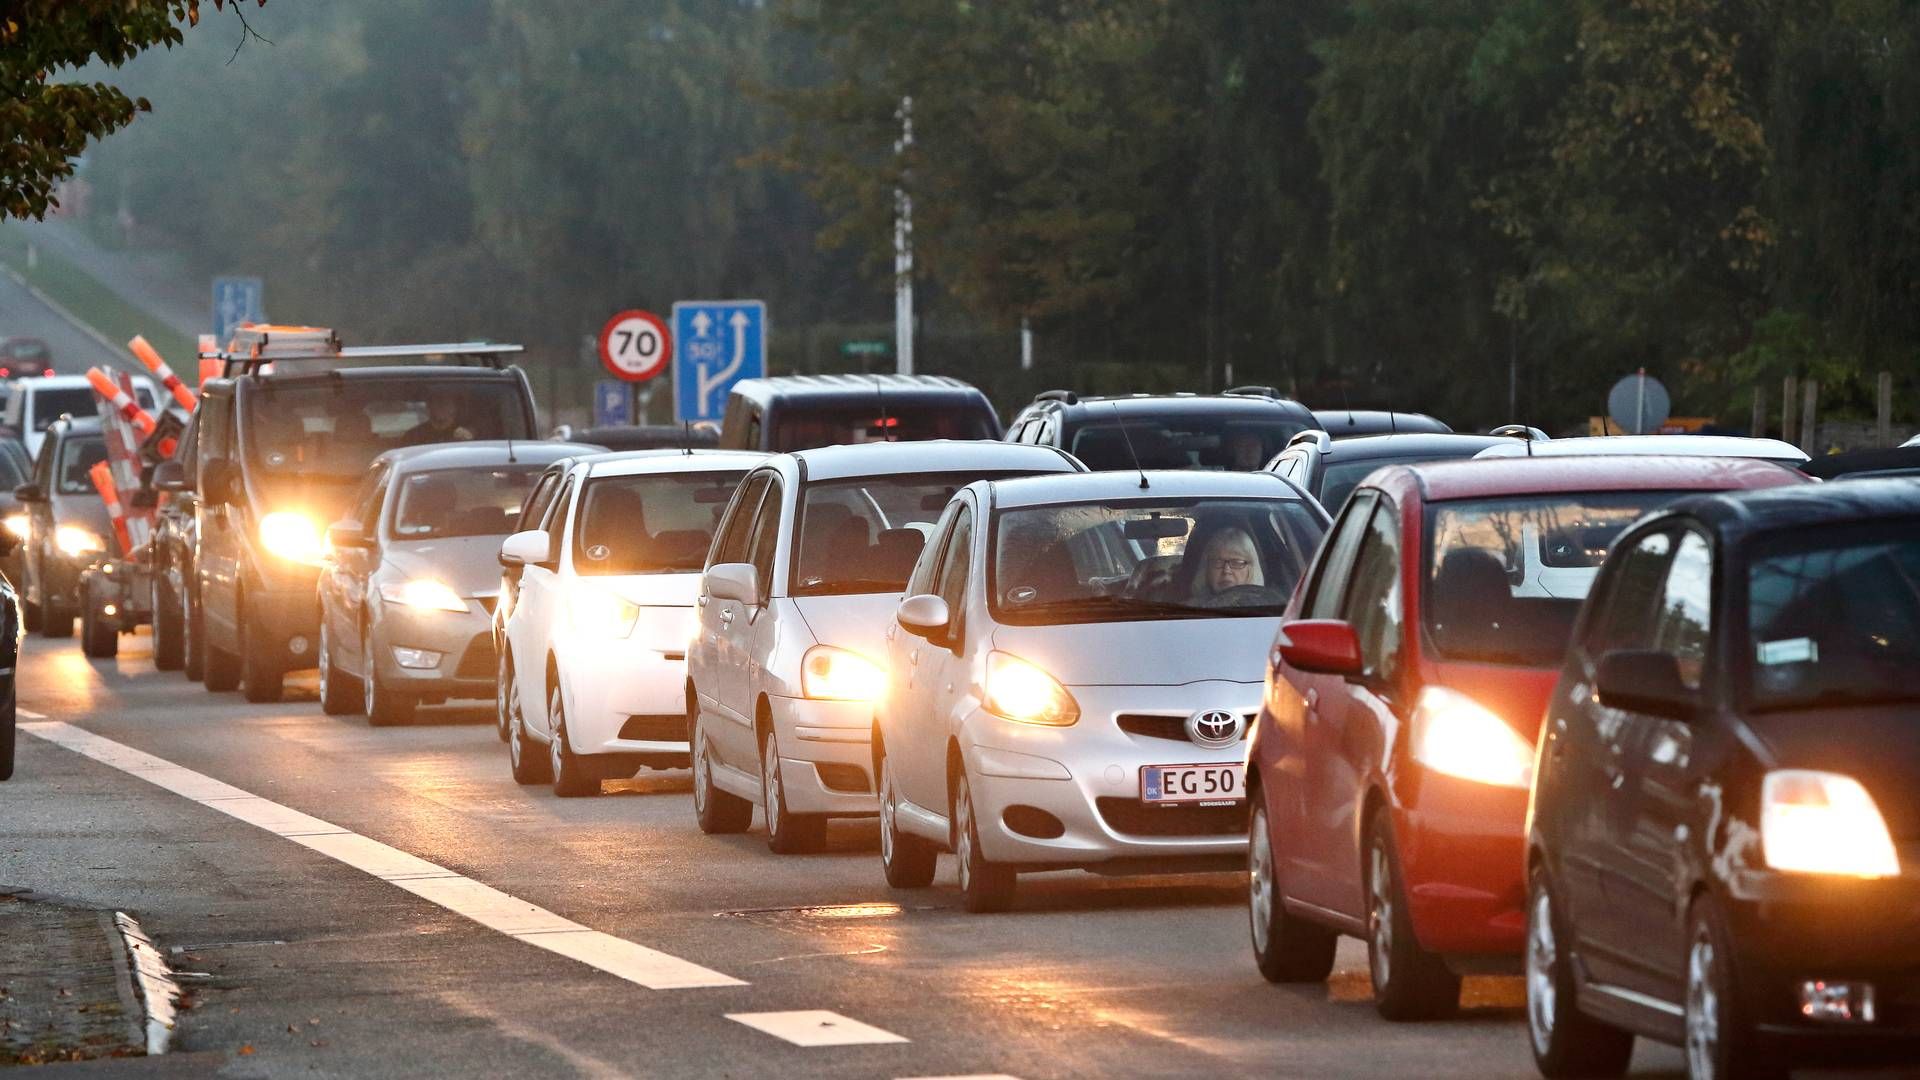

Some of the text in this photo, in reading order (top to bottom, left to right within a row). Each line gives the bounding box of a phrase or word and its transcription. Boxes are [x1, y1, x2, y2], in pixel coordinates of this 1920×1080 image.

[616, 331, 656, 357] 70
[1146, 787, 1158, 796] DK
[1163, 769, 1235, 794] EG 50
